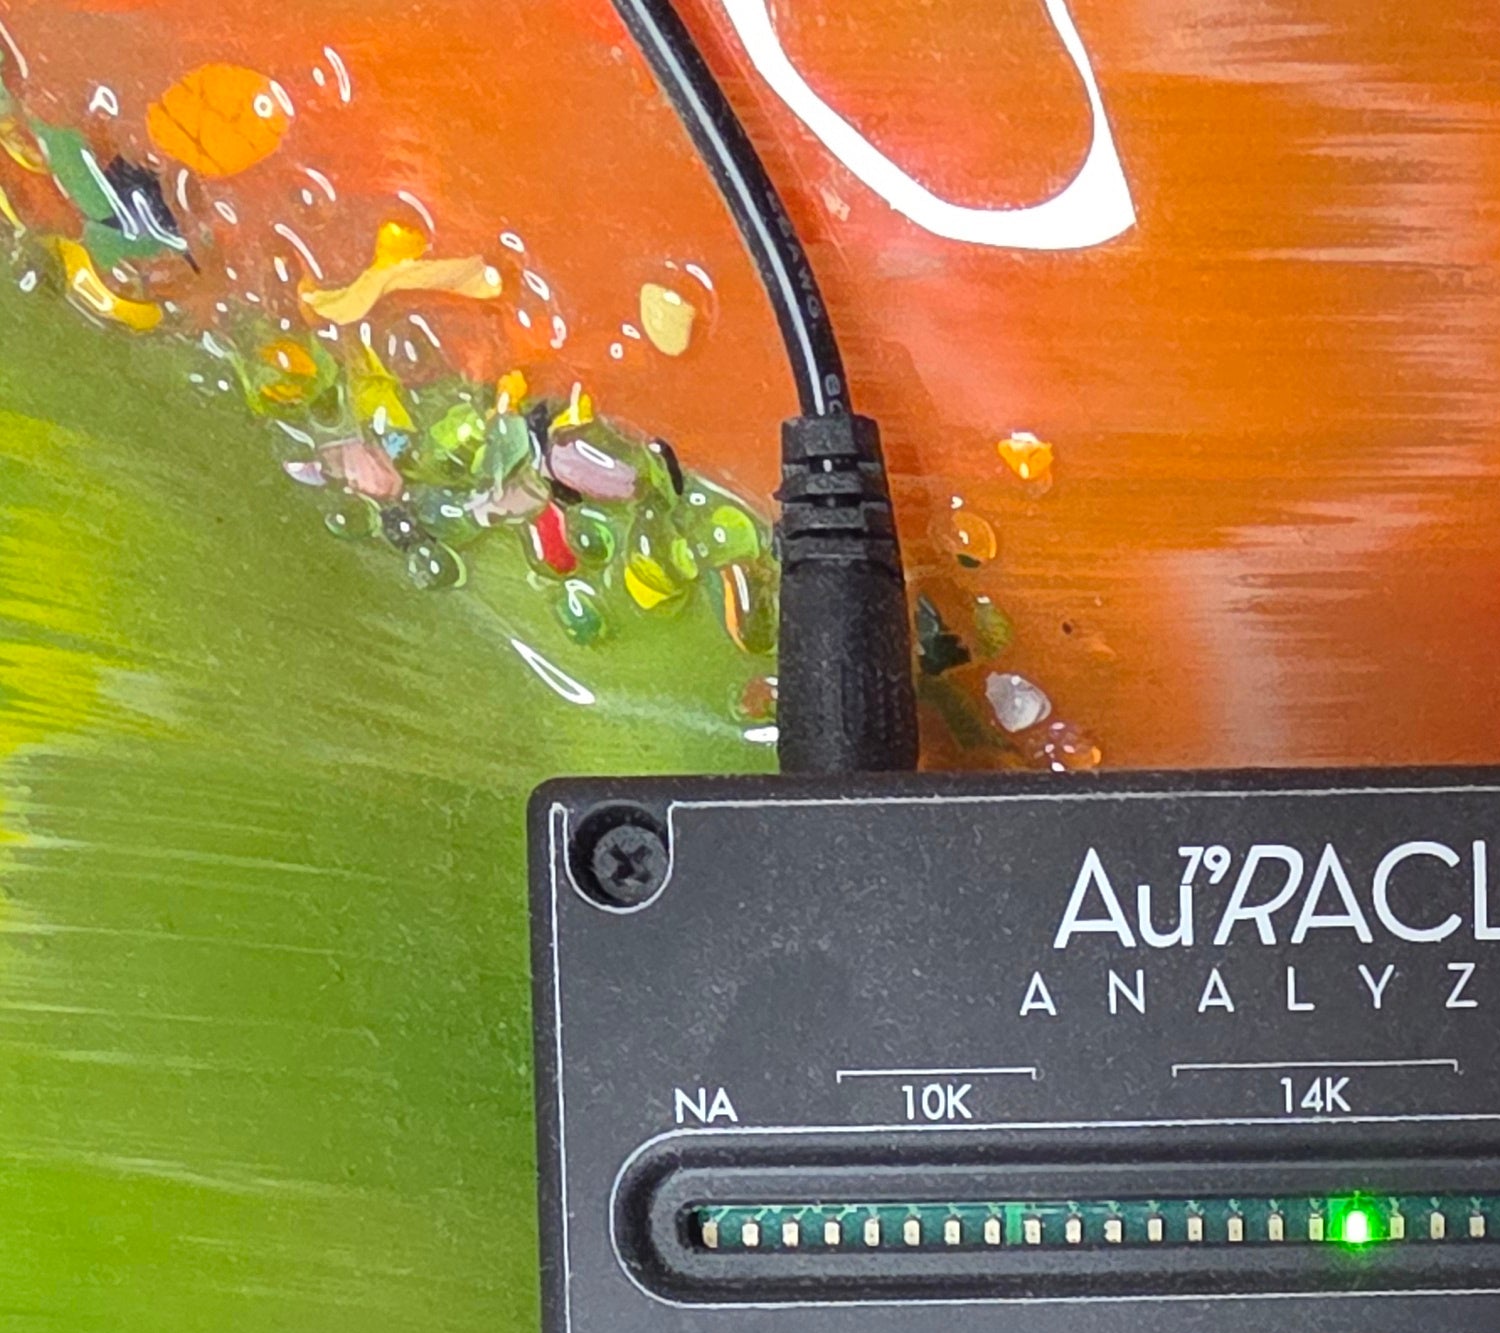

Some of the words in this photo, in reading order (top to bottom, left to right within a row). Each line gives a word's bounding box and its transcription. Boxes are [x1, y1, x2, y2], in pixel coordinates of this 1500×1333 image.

[674, 1087, 739, 1124] NA
[901, 1083, 973, 1120] 10K
[1280, 1077, 1351, 1113] 14K
